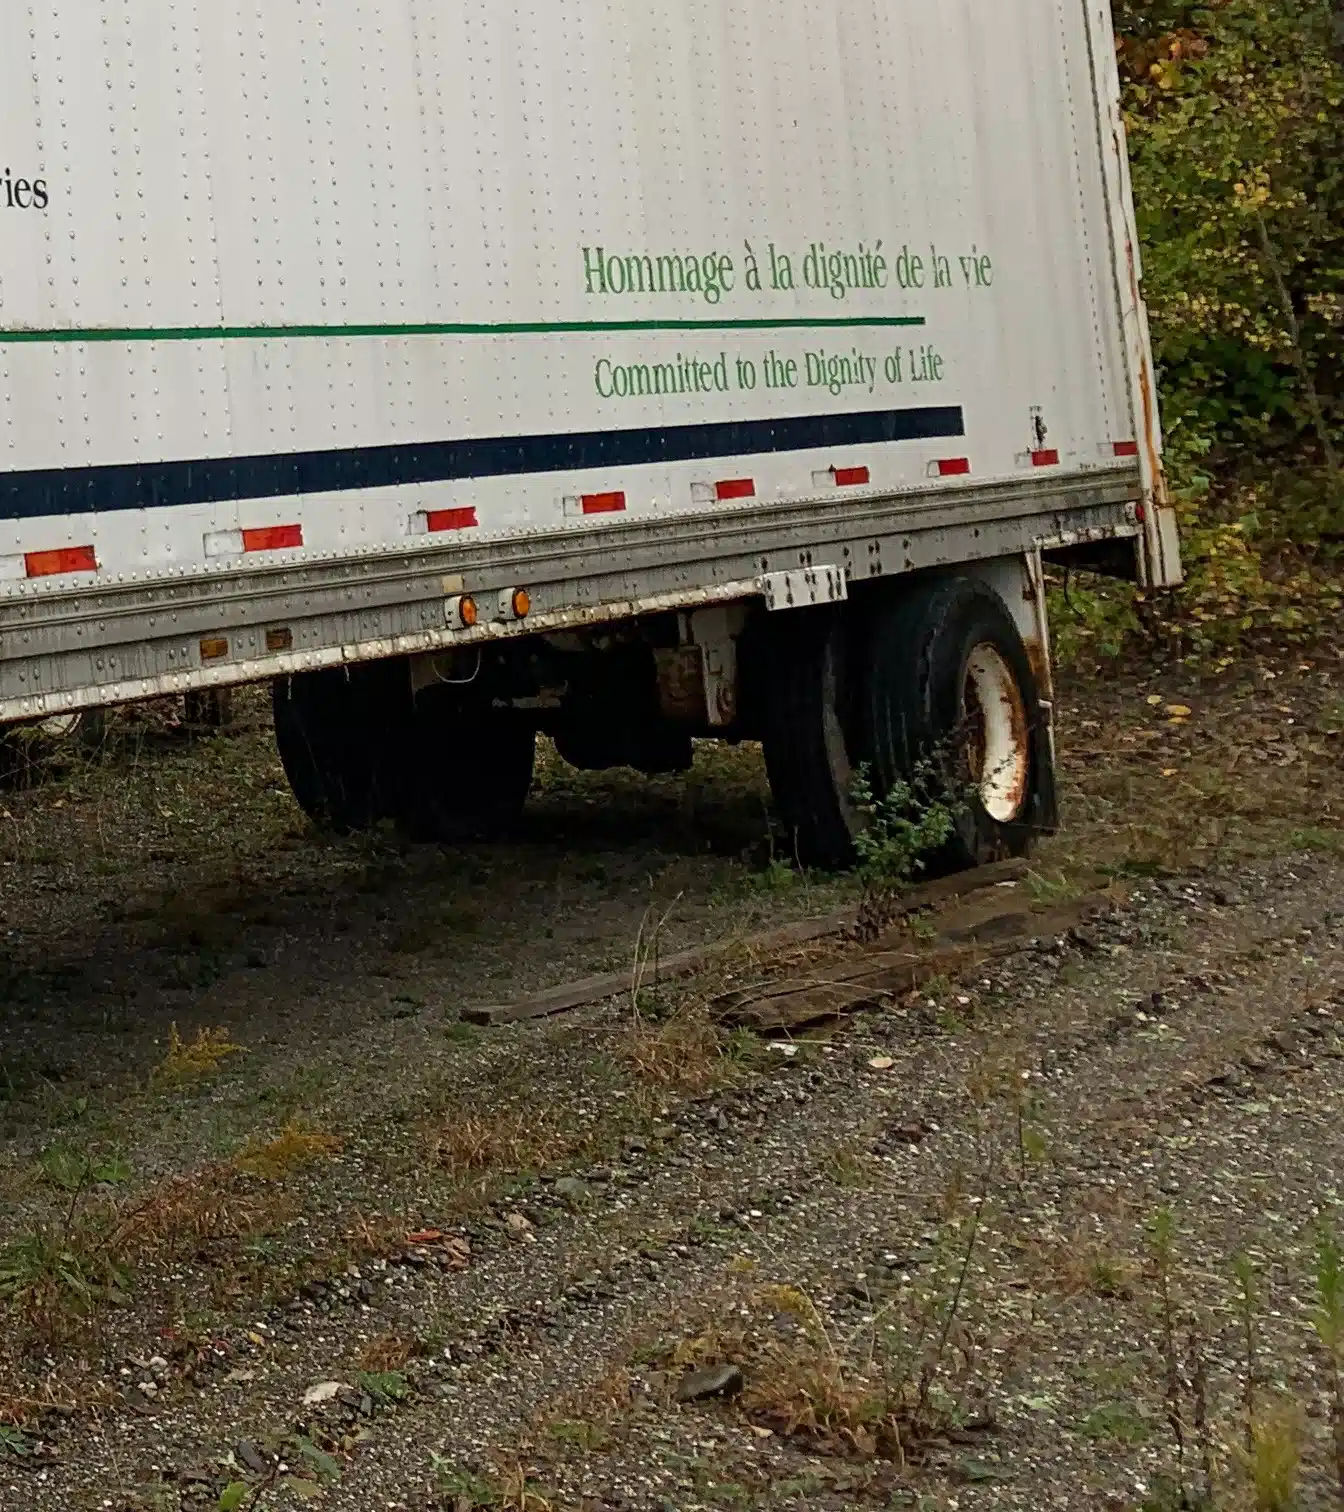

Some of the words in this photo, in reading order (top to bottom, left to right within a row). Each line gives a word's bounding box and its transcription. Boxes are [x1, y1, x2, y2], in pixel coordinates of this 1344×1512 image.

[582, 247, 734, 304] Hommage
[744, 240, 762, 291] à
[769, 243, 796, 290] la
[802, 240, 888, 299] dignité
[896, 245, 924, 289] de
[930, 243, 952, 289] la
[960, 244, 993, 289] vie
[595, 352, 728, 397] Committed
[736, 355, 757, 390] to
[763, 349, 798, 388] the
[806, 346, 876, 395] Dignity
[884, 345, 904, 384] of
[910, 345, 944, 382] Life
